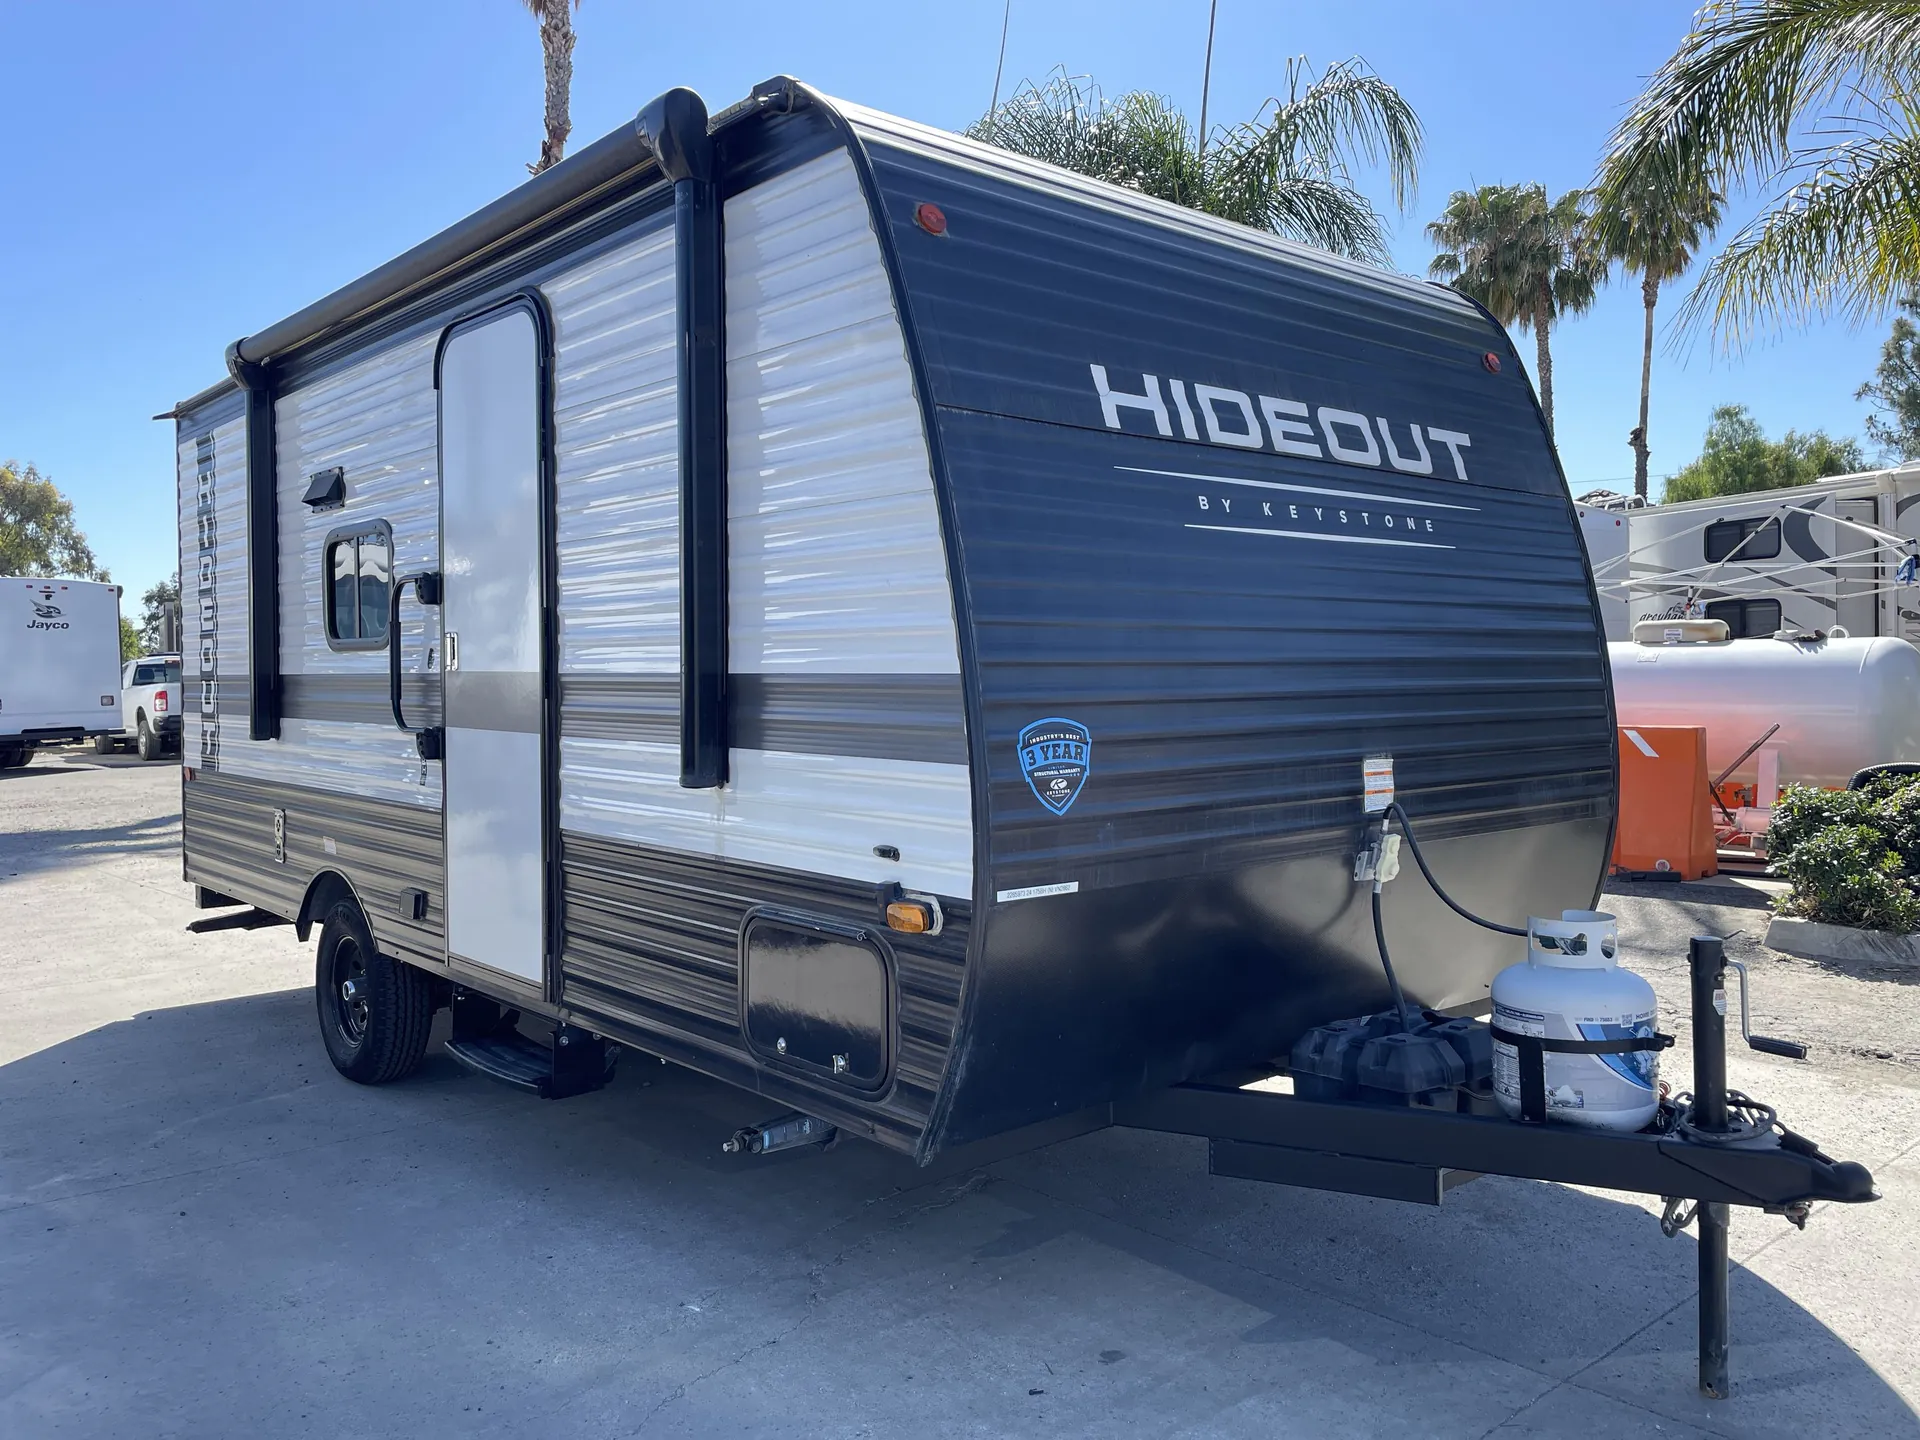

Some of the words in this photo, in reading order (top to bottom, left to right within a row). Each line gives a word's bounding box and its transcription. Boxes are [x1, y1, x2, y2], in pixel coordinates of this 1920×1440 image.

[1090, 364, 1471, 480] HIDEOUT
[1199, 495, 1231, 513] BY
[1263, 502, 1434, 532] KEYSTONE
[27, 620, 69, 631] Jayco
[199, 471, 216, 755] HIDEOUT
[1030, 734, 1064, 744] INDUSTRY'S
[1026, 750, 1037, 766] 3
[1040, 743, 1084, 761] YEAR
